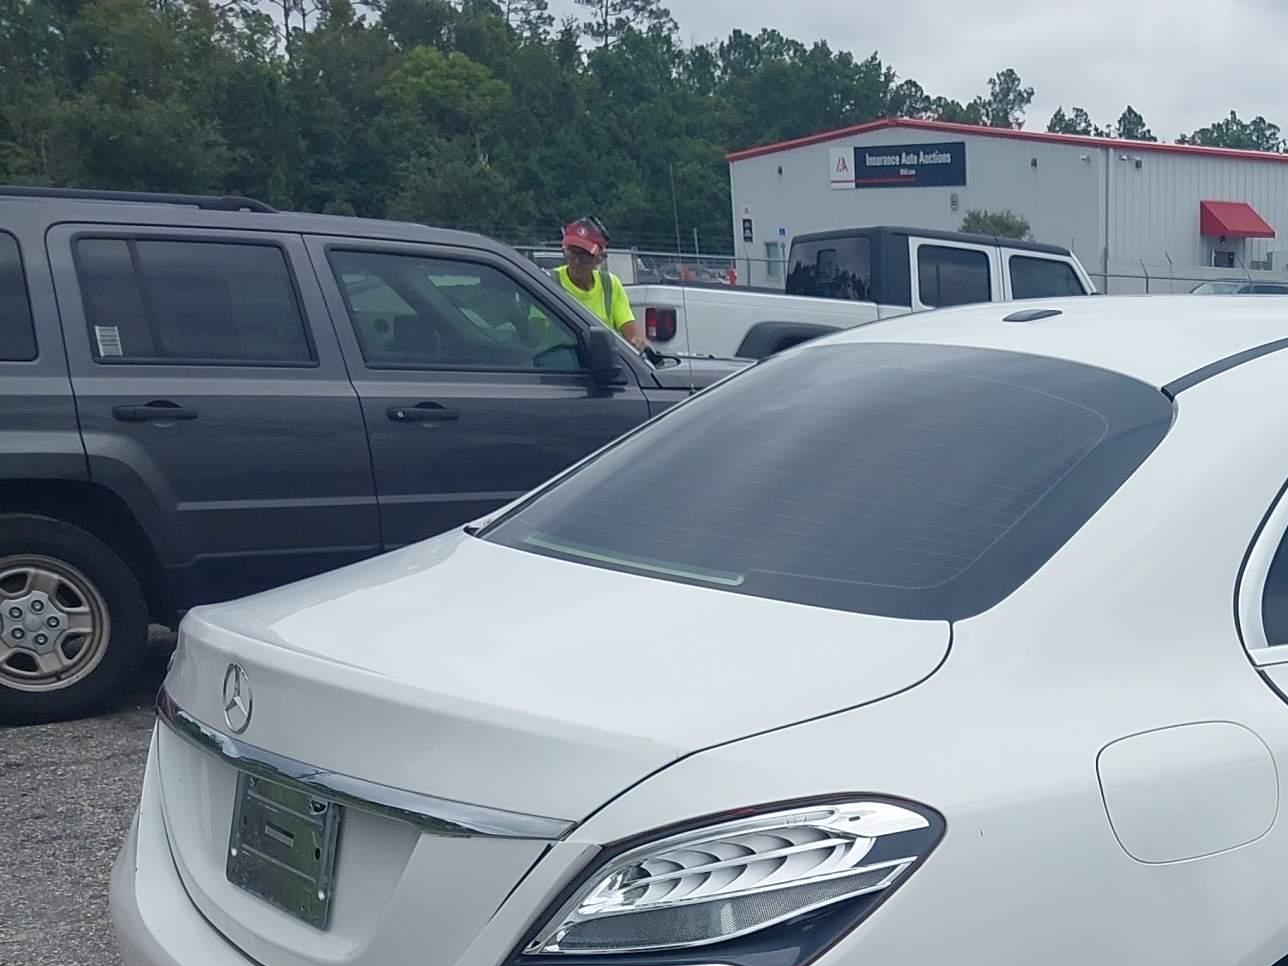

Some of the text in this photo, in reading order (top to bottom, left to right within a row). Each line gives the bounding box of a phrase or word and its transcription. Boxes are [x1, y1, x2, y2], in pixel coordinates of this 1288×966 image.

[865, 150, 952, 167] Insurance Auto Auctions
